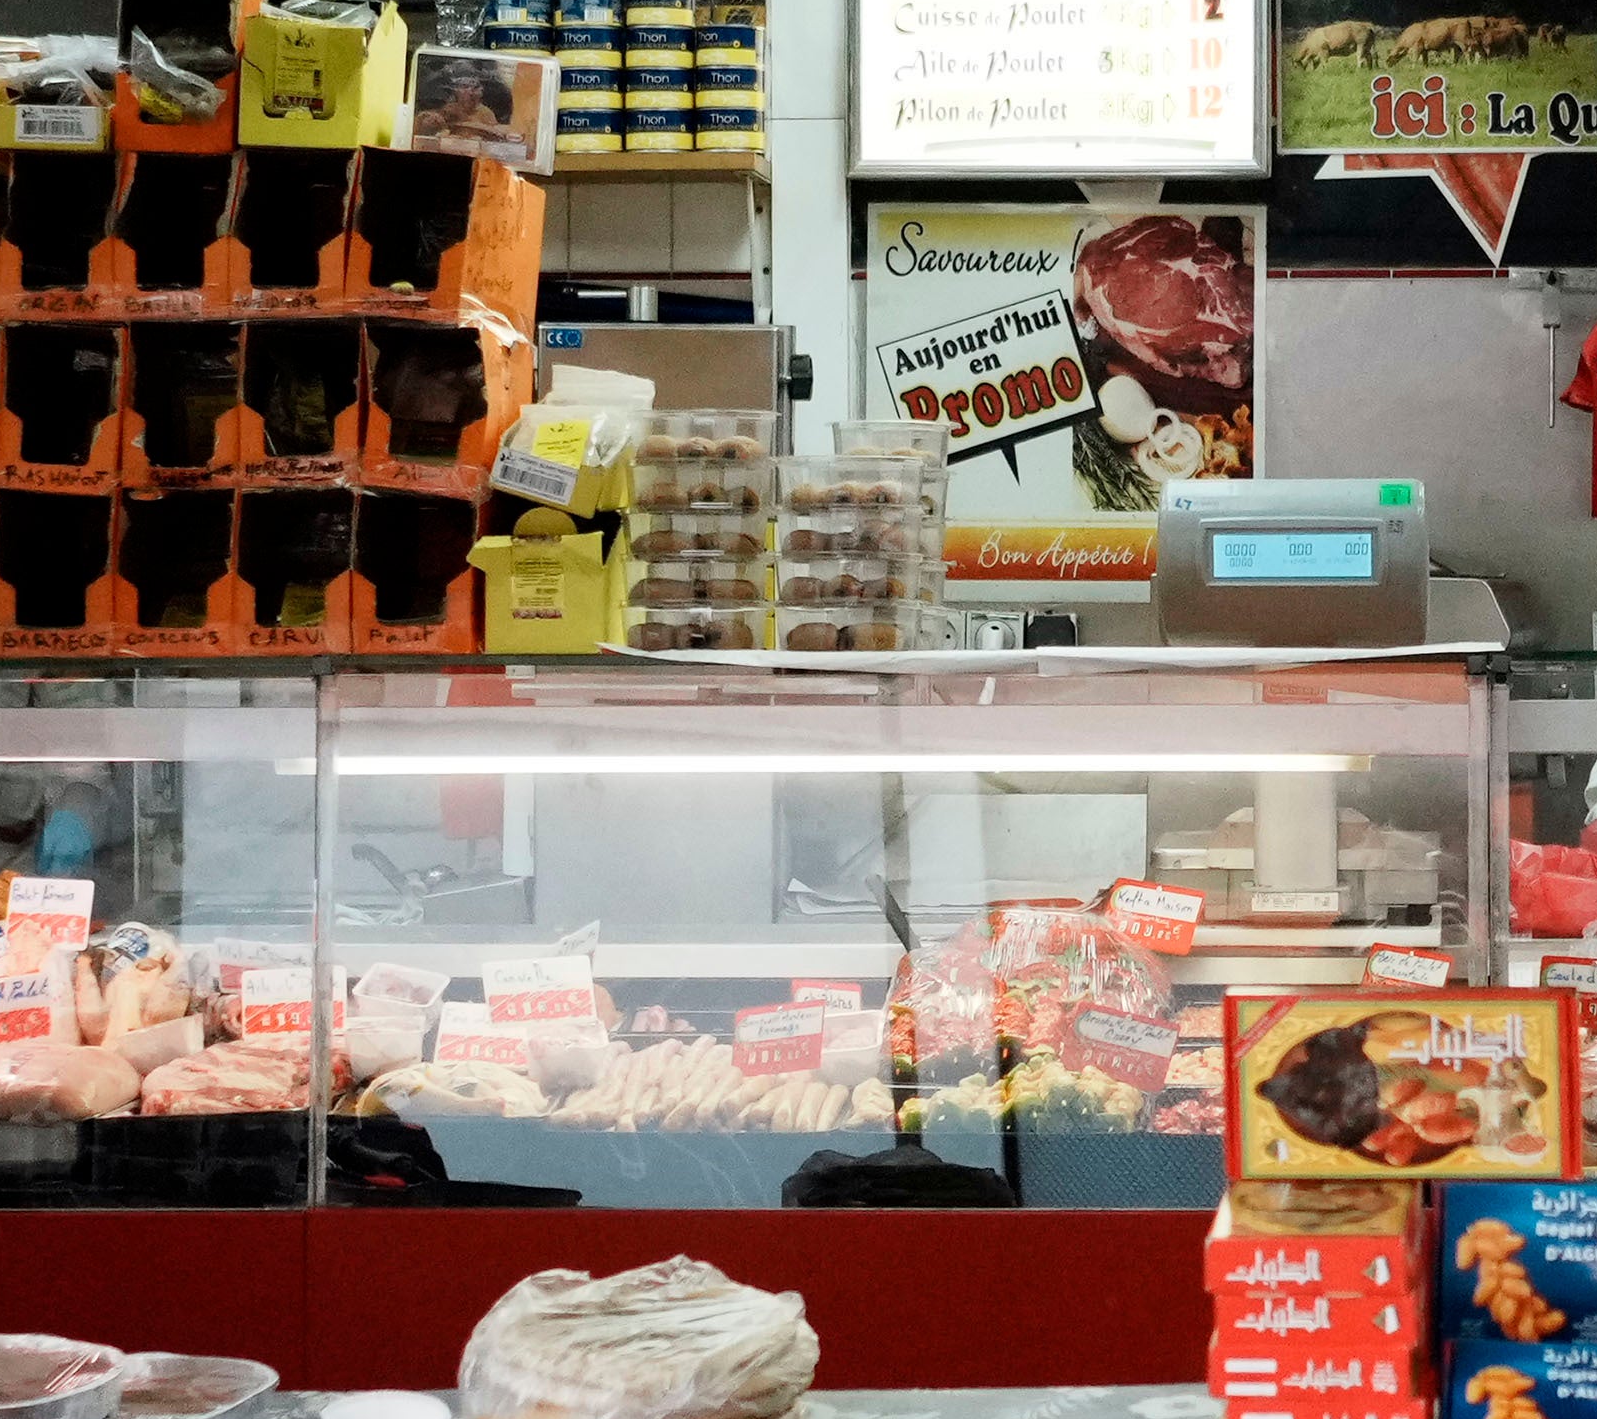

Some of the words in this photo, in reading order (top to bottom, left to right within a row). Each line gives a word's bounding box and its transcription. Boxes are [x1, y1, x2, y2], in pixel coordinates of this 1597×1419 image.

[894, 2, 978, 35] Cuisse
[1007, 1, 1087, 34] Poulet
[509, 31, 539, 43] Thon
[563, 31, 591, 43] Thon
[638, 31, 667, 43] Thon
[571, 72, 600, 84] Thon
[640, 72, 670, 84] Thon
[710, 72, 740, 83] Thon
[1371, 75, 1447, 137] ici
[1487, 93, 1536, 136] La
[636, 113, 666, 125] Thon
[709, 113, 740, 125] Thon
[894, 97, 960, 131] Pilon
[989, 97, 1068, 130] Poulet
[562, 116, 589, 127] Thon
[885, 220, 1059, 277] Savoureux
[895, 299, 1061, 376] Aujourd'hui
[969, 351, 1002, 376] en
[902, 356, 1085, 438] Promo
[978, 532, 1031, 566] Bon
[1037, 532, 1135, 578] Appétit
